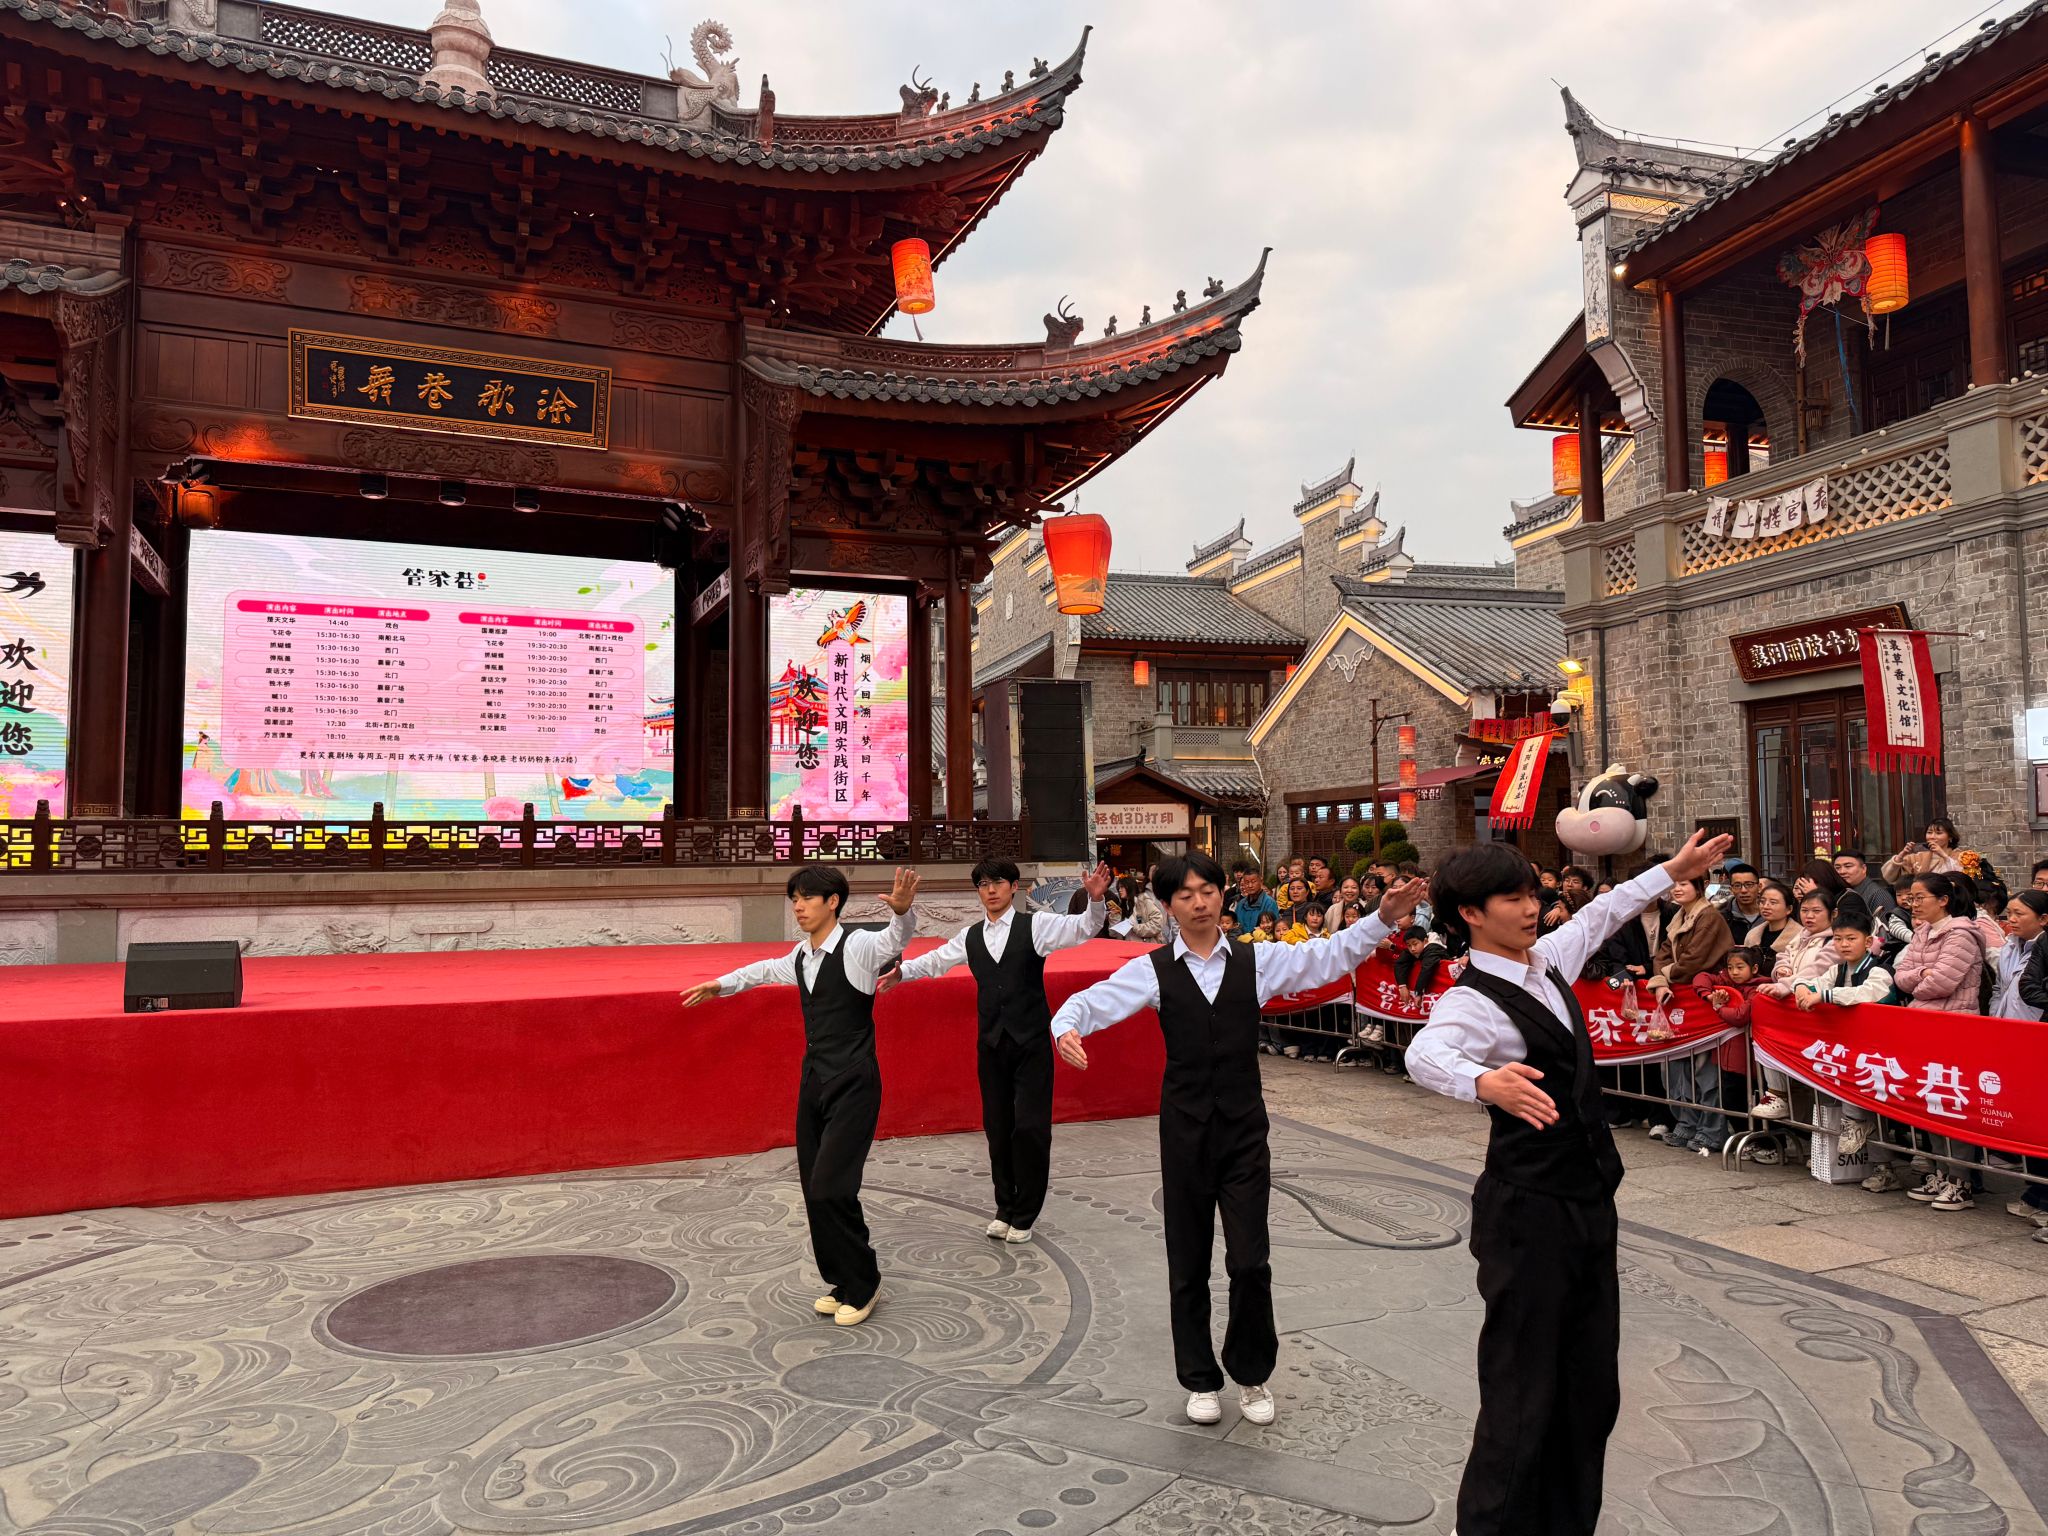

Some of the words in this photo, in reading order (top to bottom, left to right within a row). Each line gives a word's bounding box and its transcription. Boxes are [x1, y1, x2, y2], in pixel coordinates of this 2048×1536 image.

[402, 568, 475, 589] 管家巷
[0, 637, 38, 756] 欢迎您
[383, 709, 397, 717] 北门
[795, 674, 821, 770] 欢迎您
[833, 652, 849, 803] 新时代文明实践街区
[358, 752, 405, 761] 每周五-周日
[1801, 1039, 1971, 1120] 管家巷
[1980, 1097, 1994, 1106] THE
[1980, 1107, 2013, 1119] GUANJIA
[1982, 1117, 2004, 1127] ALLEY
